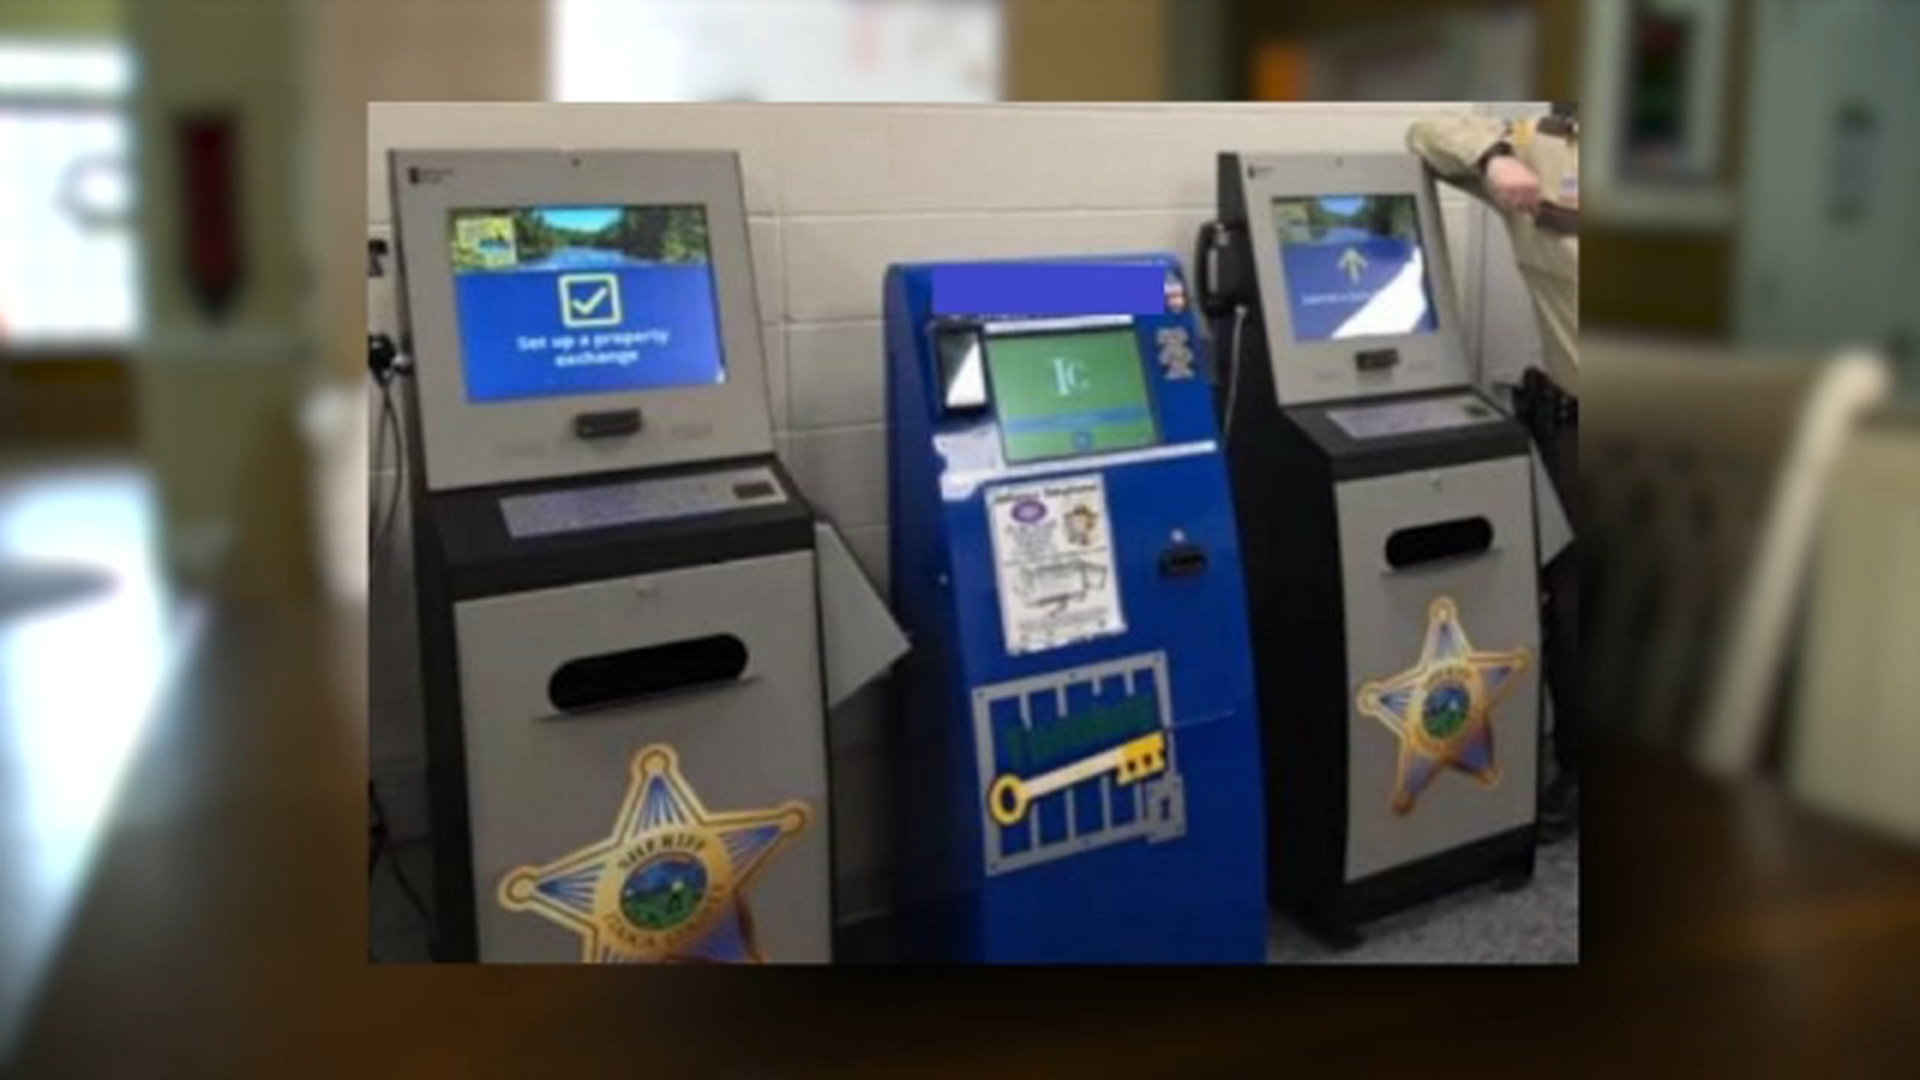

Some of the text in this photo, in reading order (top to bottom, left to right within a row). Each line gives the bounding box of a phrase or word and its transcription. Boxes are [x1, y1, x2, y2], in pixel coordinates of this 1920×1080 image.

[517, 329, 670, 351] Set up a property
[554, 349, 639, 367] exchange
